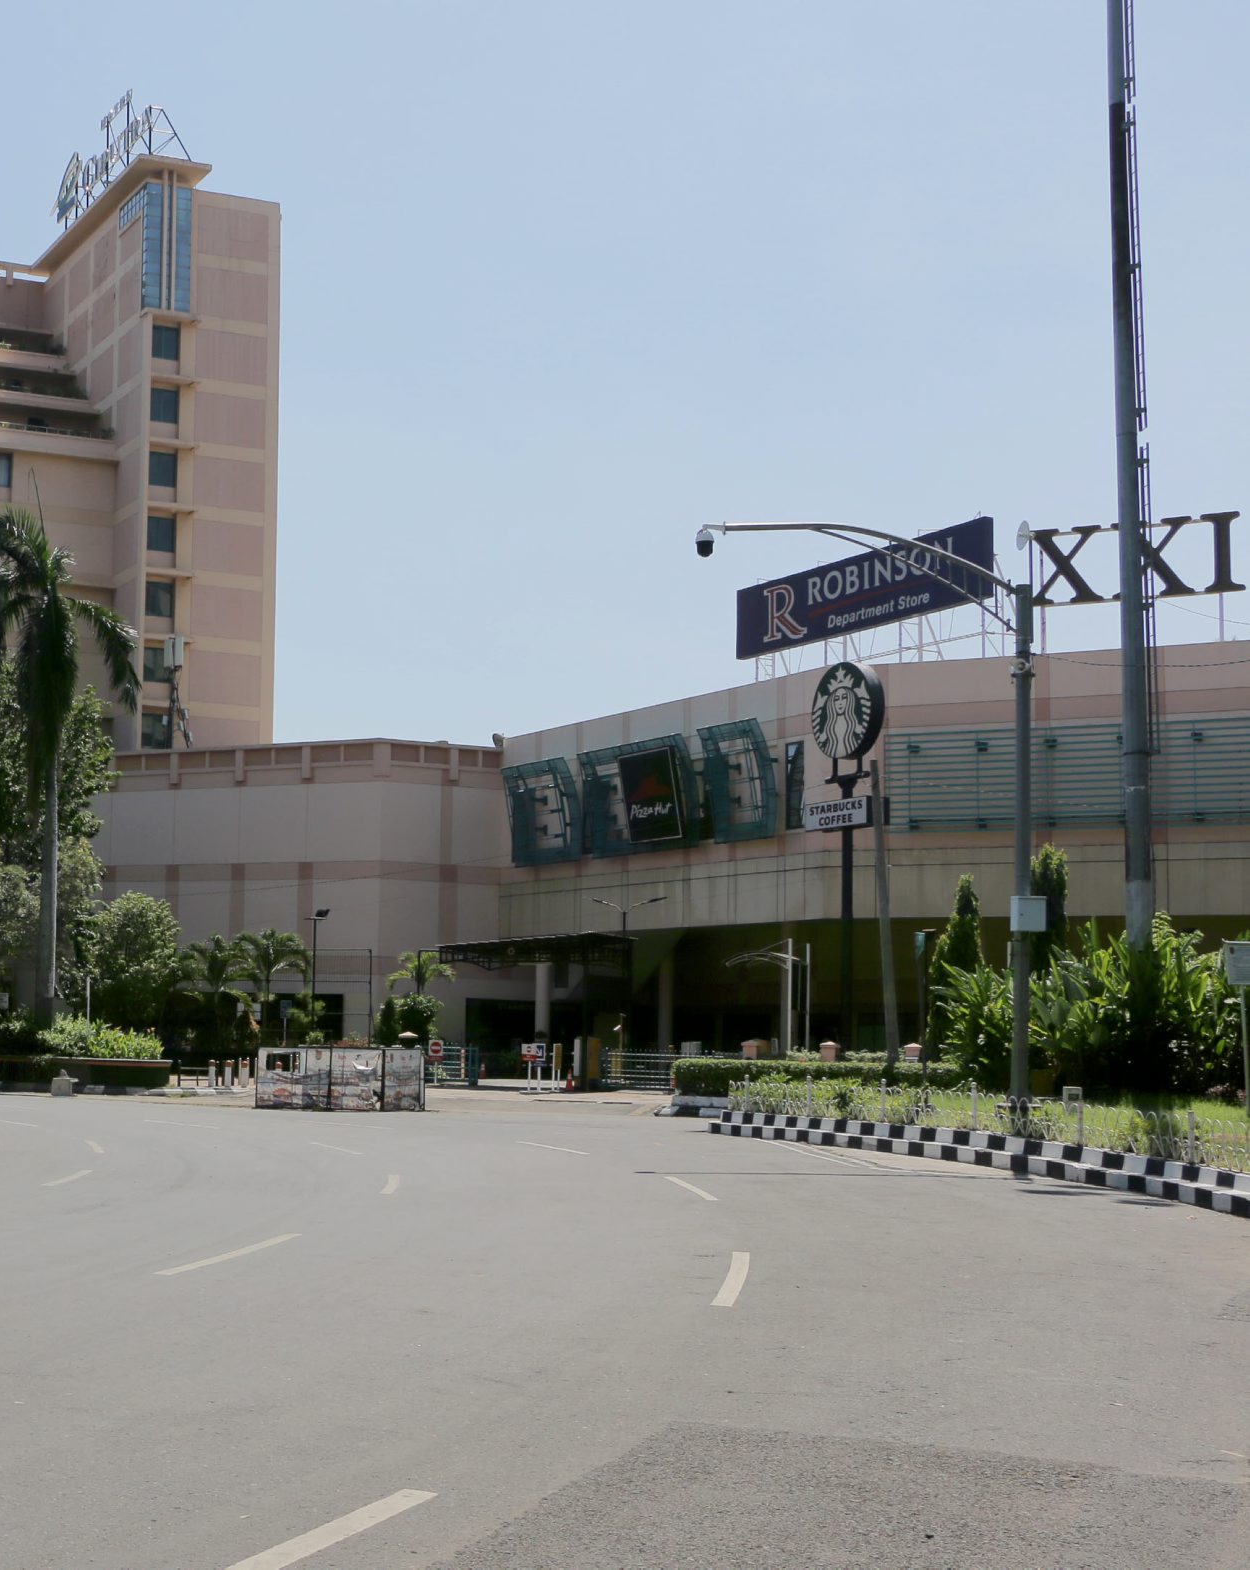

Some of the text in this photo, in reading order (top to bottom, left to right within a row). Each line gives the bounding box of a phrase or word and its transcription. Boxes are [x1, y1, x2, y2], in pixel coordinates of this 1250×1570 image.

[807, 537, 953, 606] ROBINSON
[763, 584, 807, 643] R
[827, 591, 930, 629] Department Store
[630, 802, 672, 820] Pizza Hut
[809, 800, 863, 816] STARBUCKS
[818, 813, 853, 826] COFFEE
